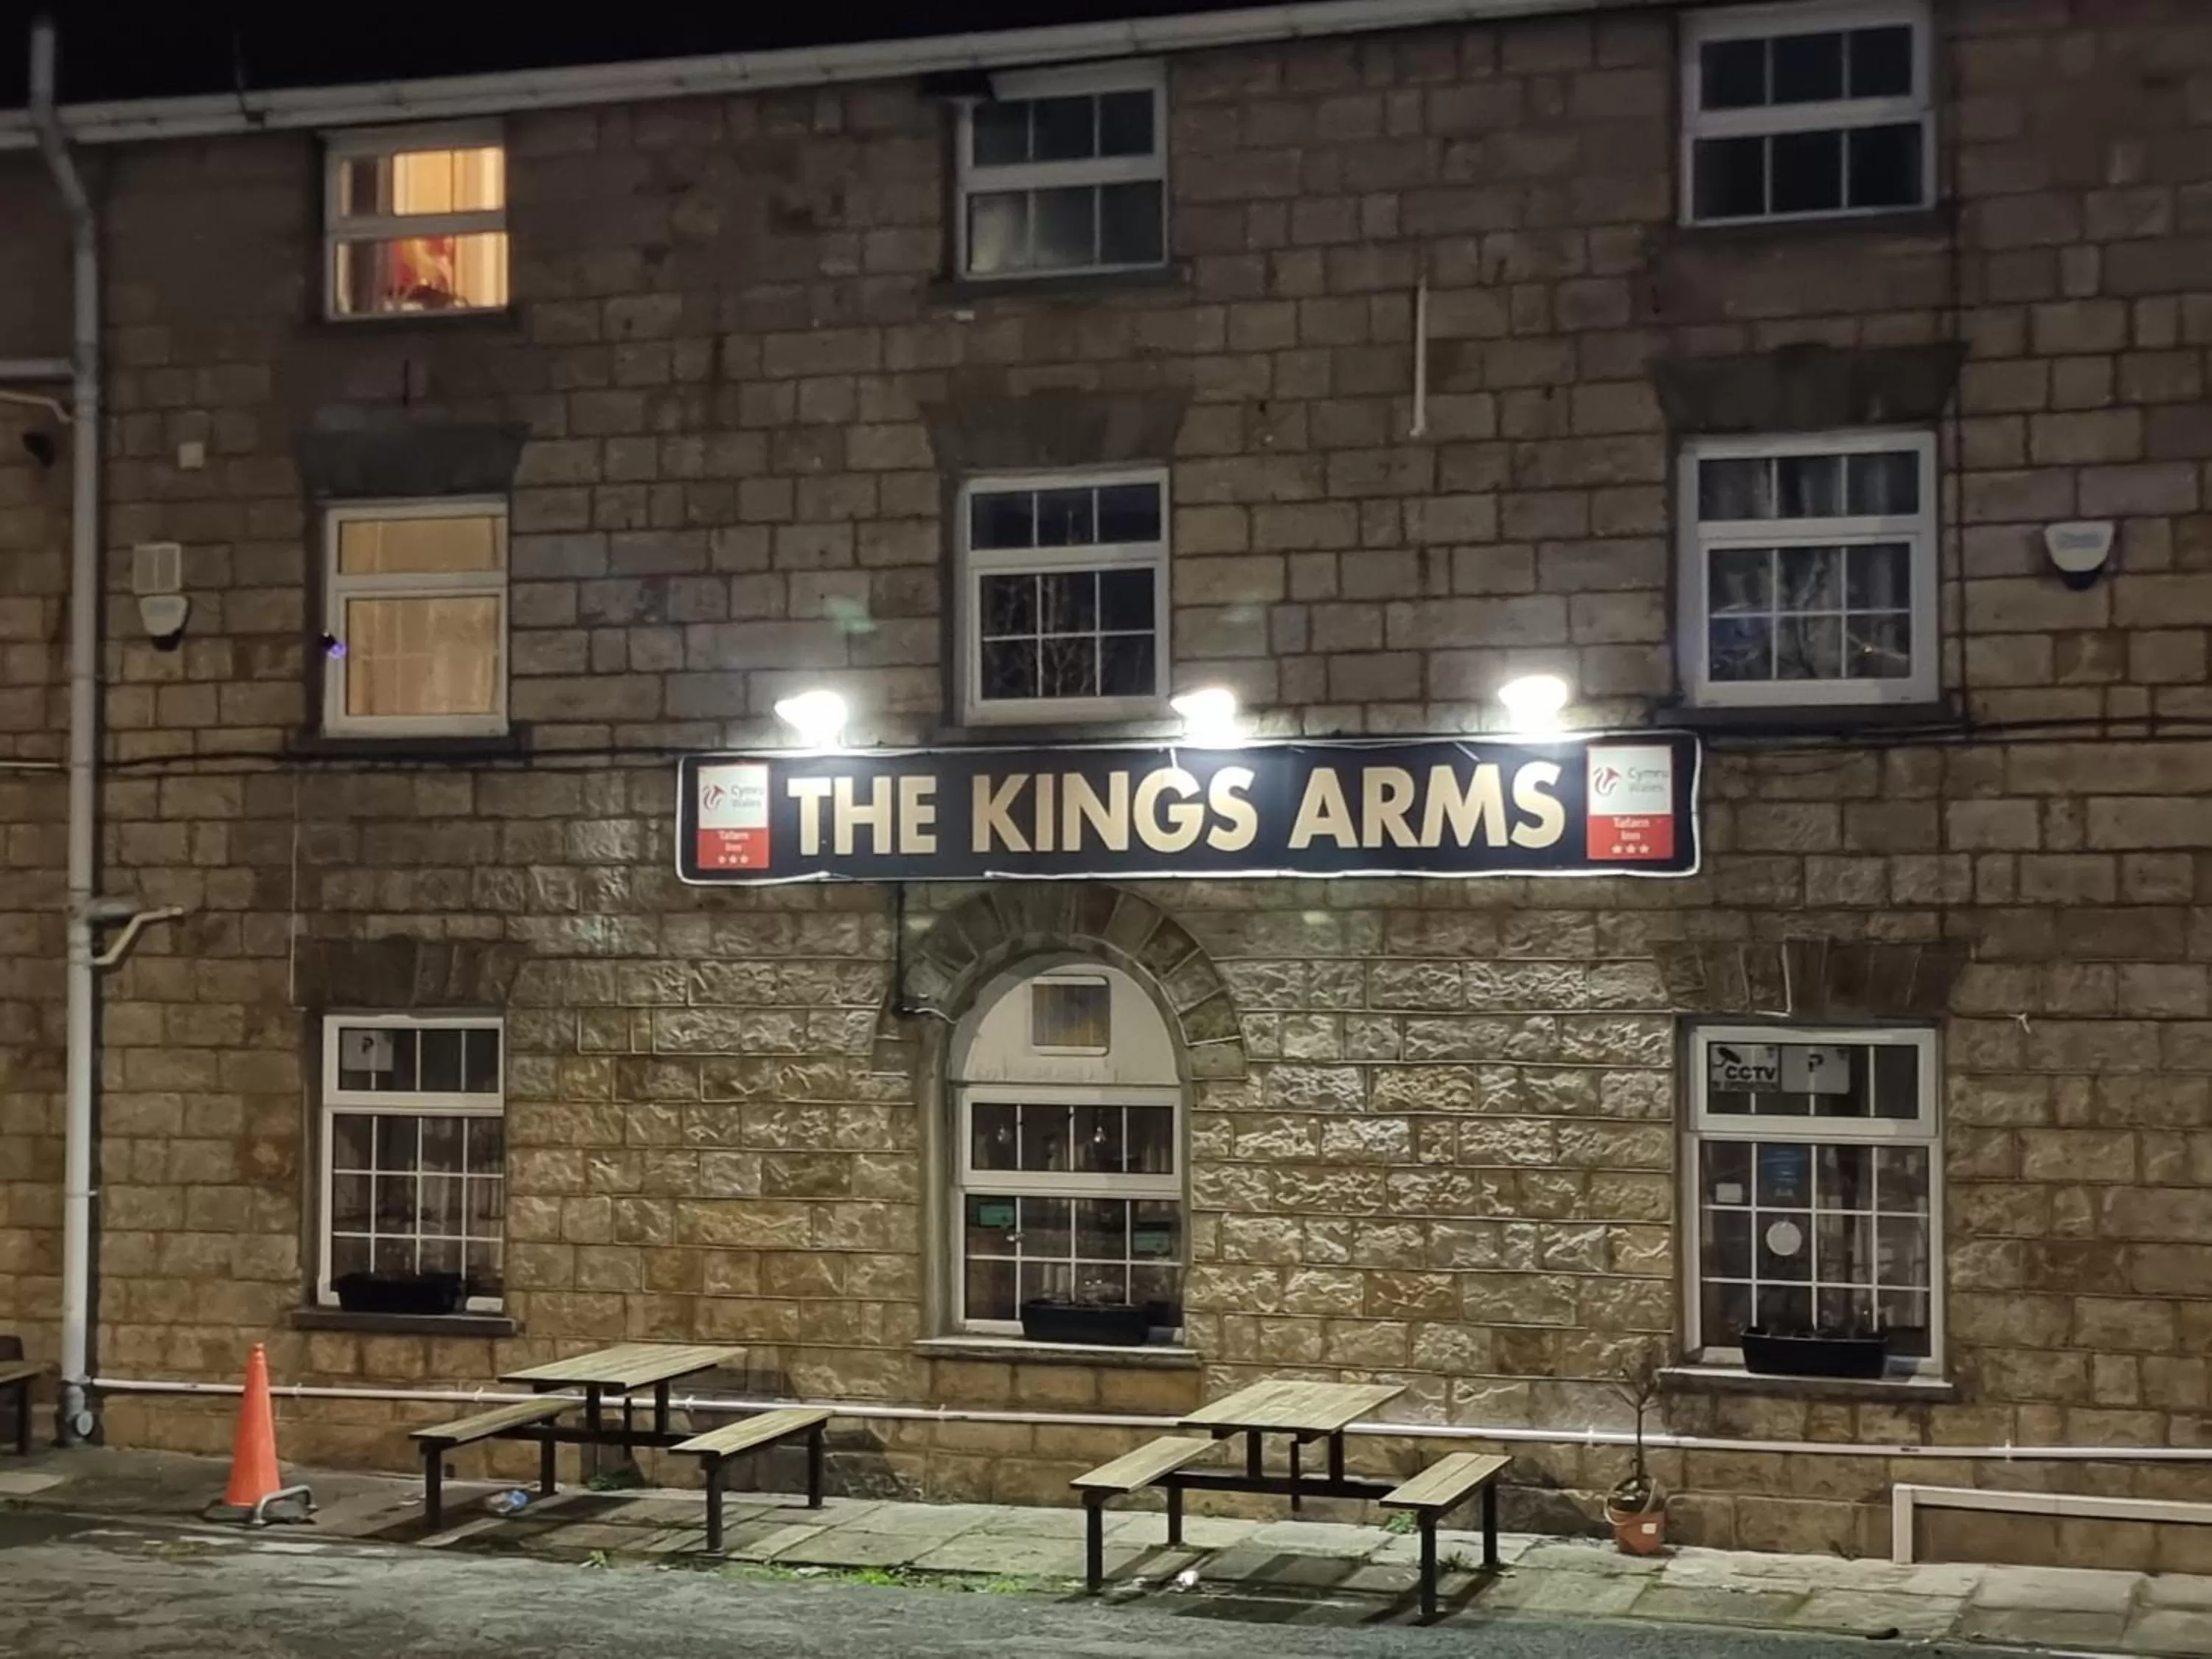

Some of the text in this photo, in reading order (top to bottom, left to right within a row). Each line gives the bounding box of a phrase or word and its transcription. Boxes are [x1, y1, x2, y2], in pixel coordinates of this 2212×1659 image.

[787, 761, 1566, 856] THE KINGS ARMS
[1725, 1066, 1776, 1080] CCTV
